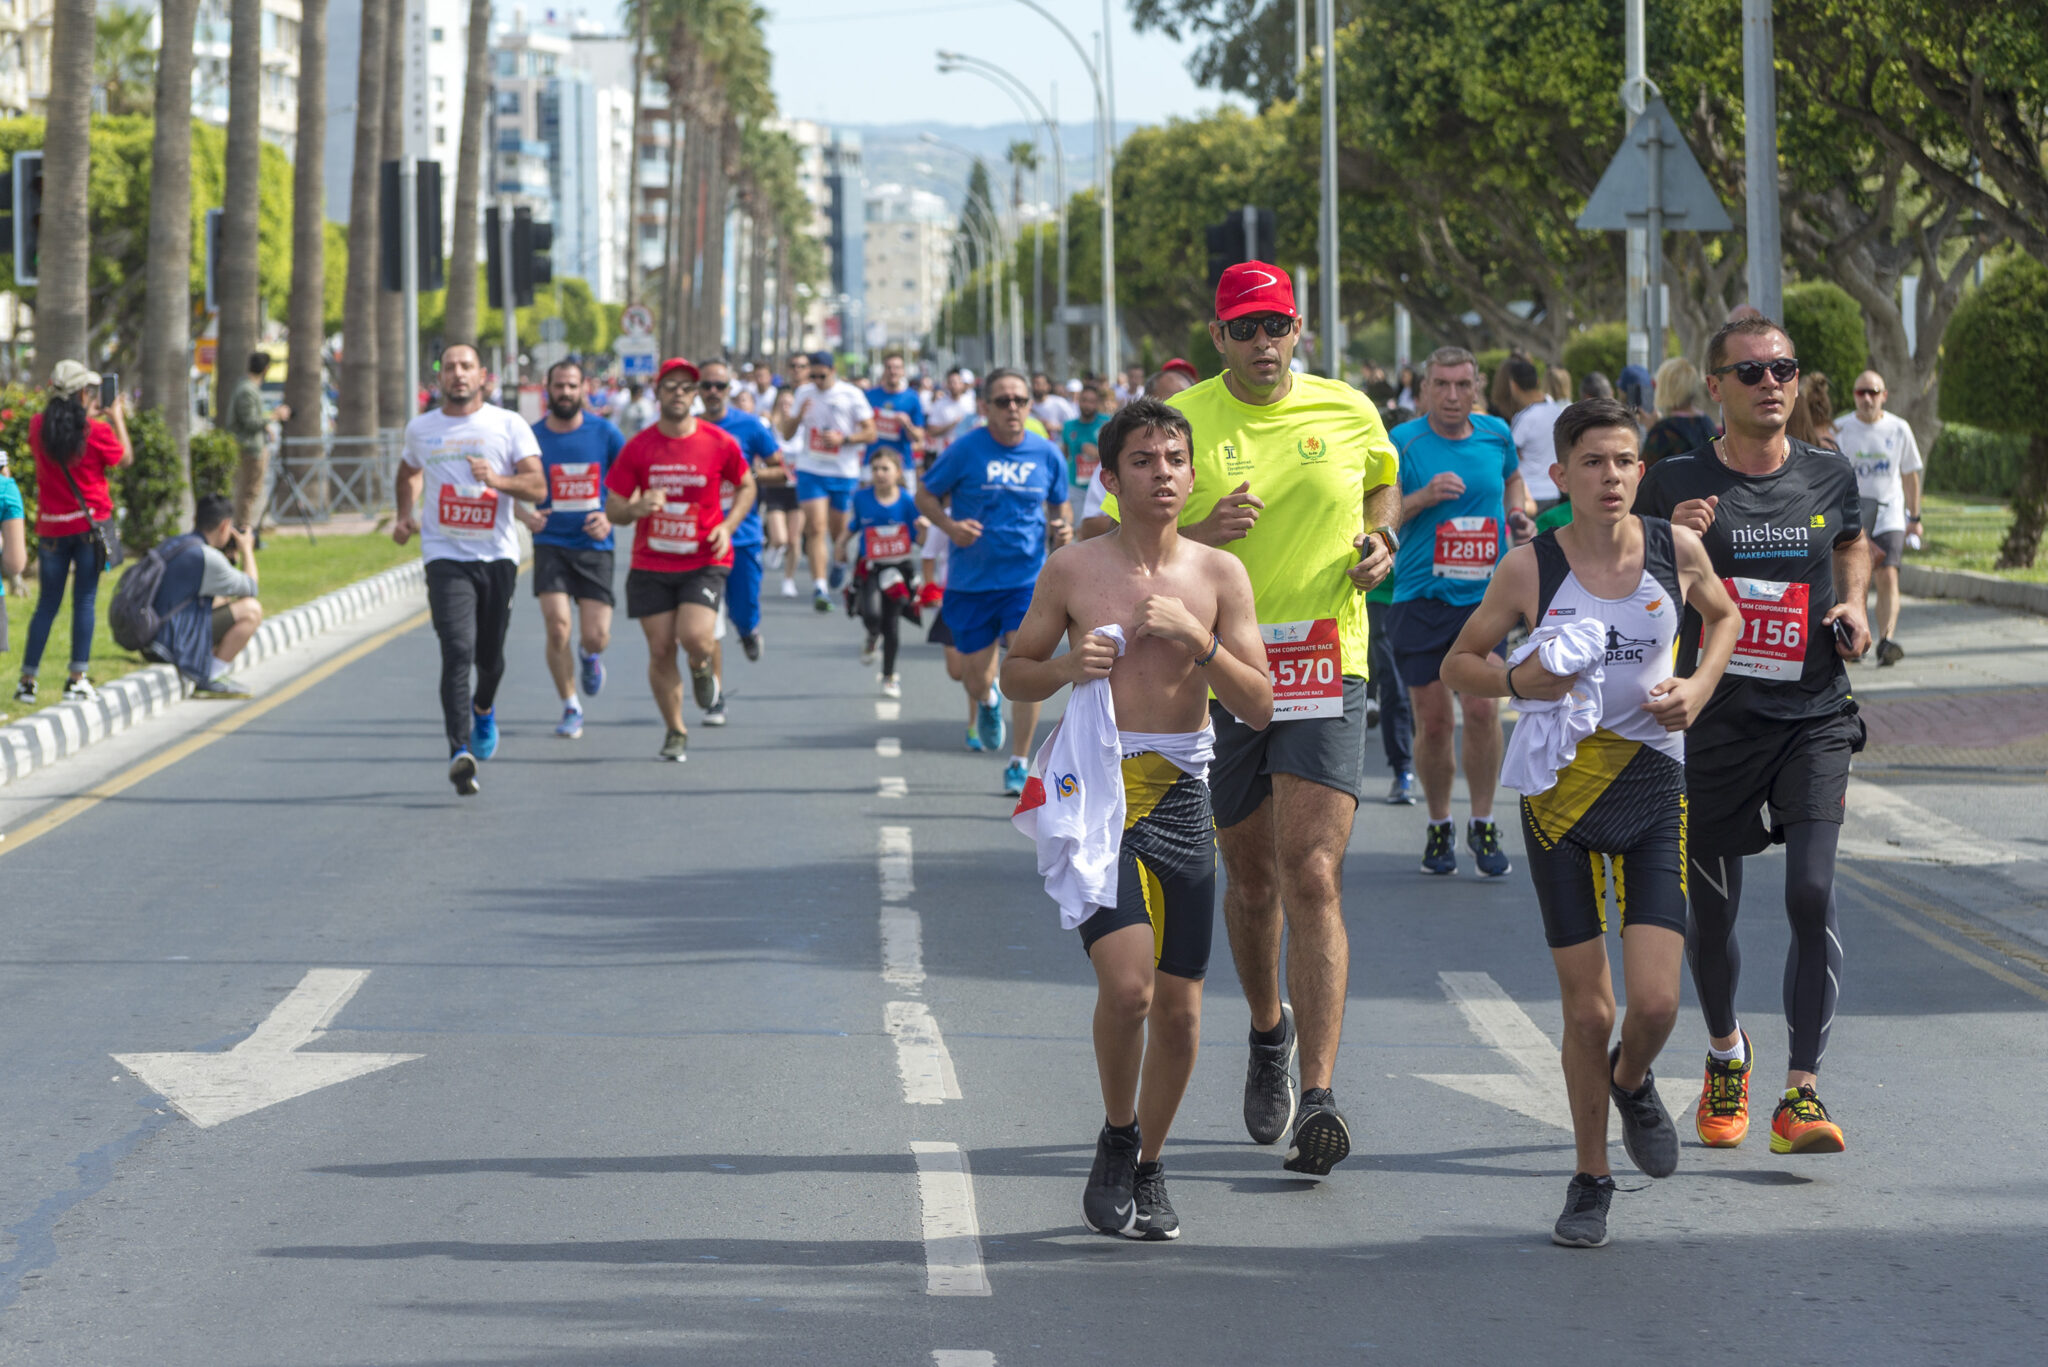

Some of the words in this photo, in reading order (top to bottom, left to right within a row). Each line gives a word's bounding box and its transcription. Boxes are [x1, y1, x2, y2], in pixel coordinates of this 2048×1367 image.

[986, 460, 1037, 484] PKF
[443, 504, 493, 523] 13703
[1732, 522, 1808, 543] nielsen
[1442, 541, 1495, 559] 12818
[1733, 549, 1808, 560] #MAKEADIFFERENCE
[1755, 604, 1788, 613] CORPORATE
[1282, 645, 1317, 653] CORPORATE
[1604, 649, 1644, 666] ρεας
